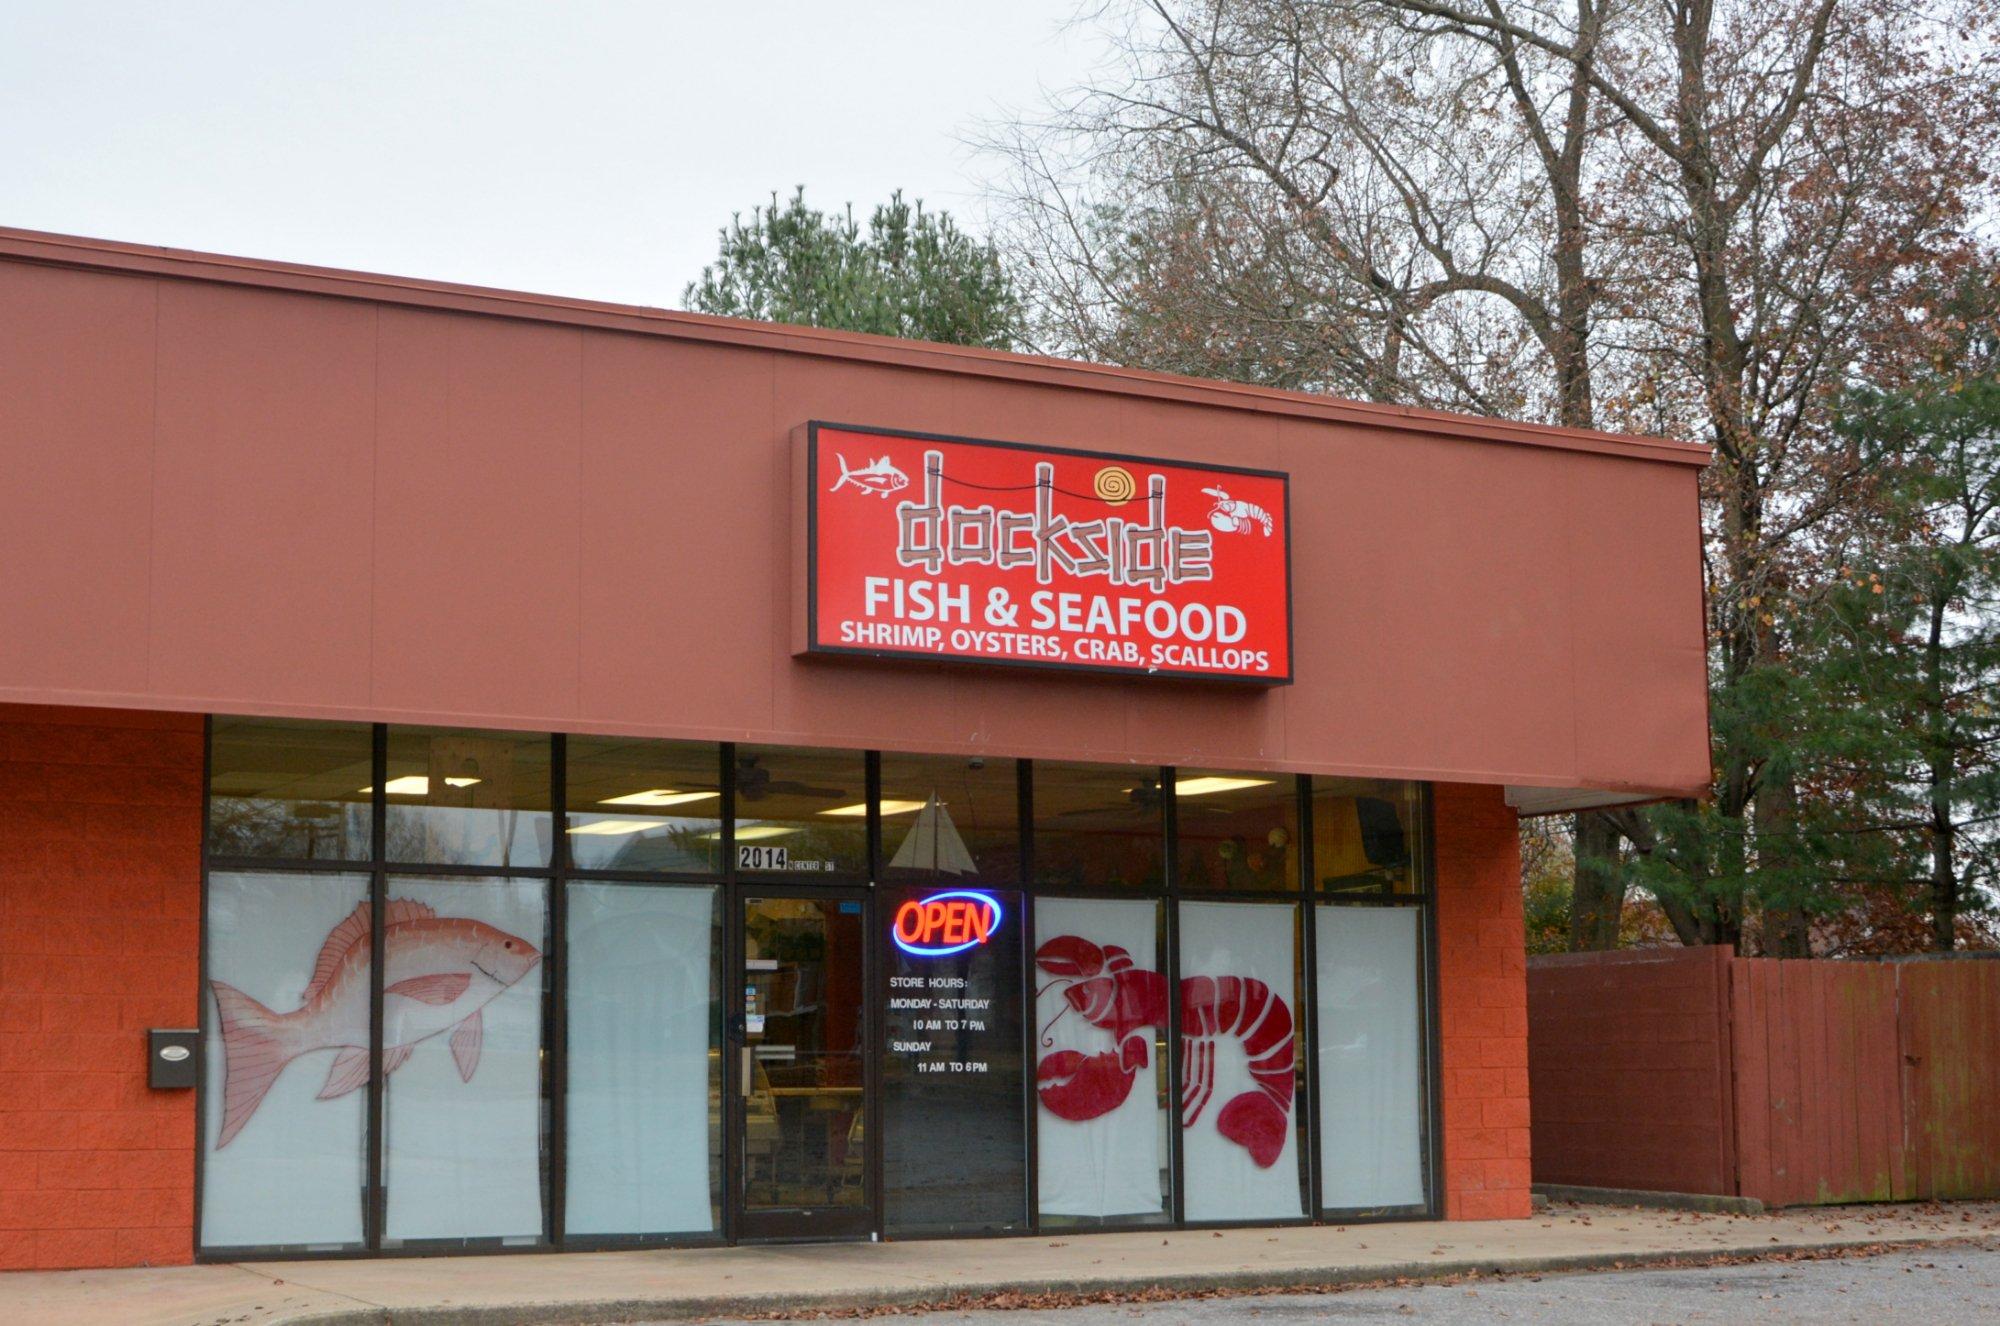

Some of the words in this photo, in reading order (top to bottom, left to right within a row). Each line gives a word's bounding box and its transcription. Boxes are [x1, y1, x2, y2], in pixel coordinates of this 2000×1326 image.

[864, 576, 971, 624] FISH
[984, 586, 1019, 628] &
[1030, 590, 1247, 644] SEAFOOD
[840, 620, 945, 652] SHRIMP,
[950, 628, 1068, 661] OYSTERS,
[1073, 638, 1146, 666] CRAB,
[1150, 643, 1269, 671] SCALLOPS
[741, 847, 786, 868] 2014
[896, 901, 991, 943] OPEN
[890, 977, 924, 988] STORE
[929, 977, 968, 988] HOURS:
[890, 998, 932, 1009] MONDAY
[938, 998, 990, 1009] SATURDAY
[913, 1019, 924, 1030] 10
[925, 1019, 942, 1030] AM
[945, 1019, 958, 1030] TO
[961, 1019, 967, 1030] 7
[969, 1020, 985, 1031] PM
[893, 1041, 932, 1052] SUNDAY
[917, 1062, 927, 1072] 11
[929, 1062, 945, 1072] AM
[950, 1062, 963, 1072] TO
[965, 1062, 971, 1072] 6
[972, 1062, 987, 1072] PM
